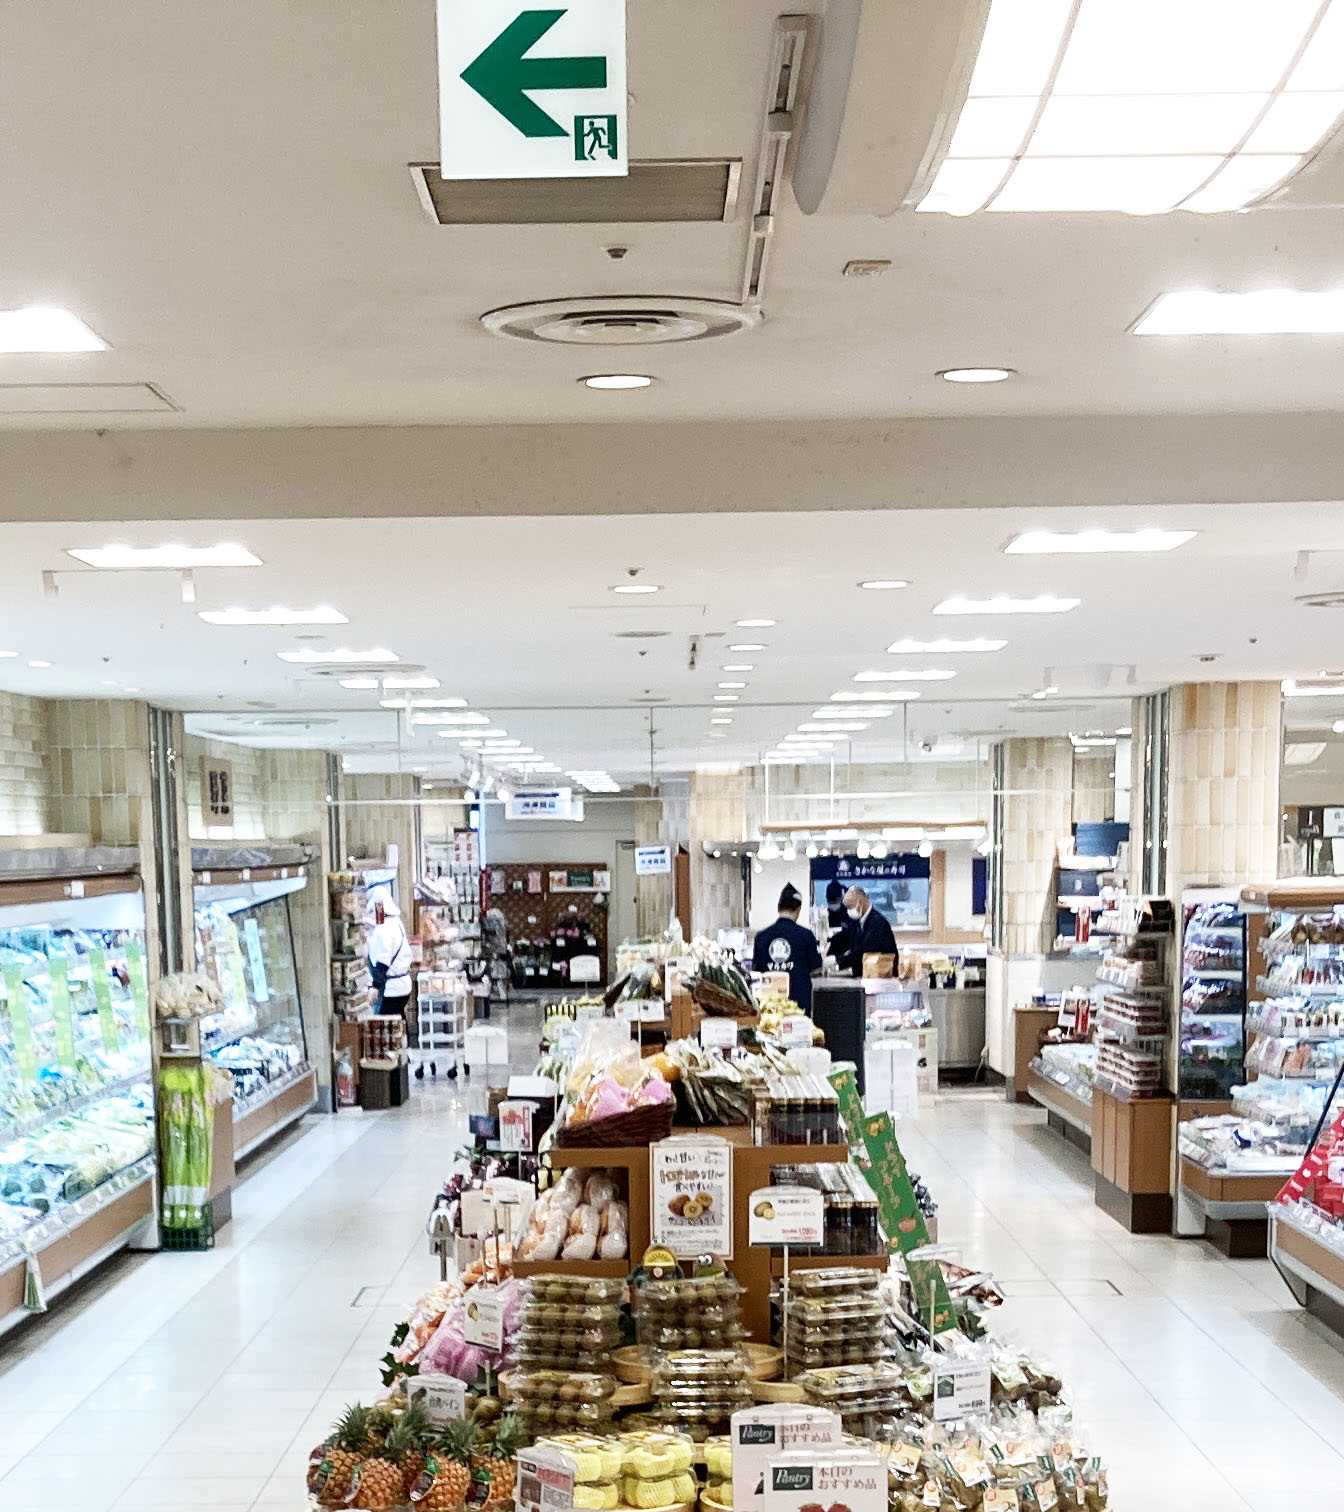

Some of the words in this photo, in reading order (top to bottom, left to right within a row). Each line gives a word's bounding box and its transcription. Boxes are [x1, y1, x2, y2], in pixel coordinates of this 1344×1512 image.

[742, 1425, 774, 1443] Pantry
[775, 1468, 811, 1489] Pantry
[818, 1467, 854, 1478] 本日の
[817, 1478, 878, 1491] おすすめ品
